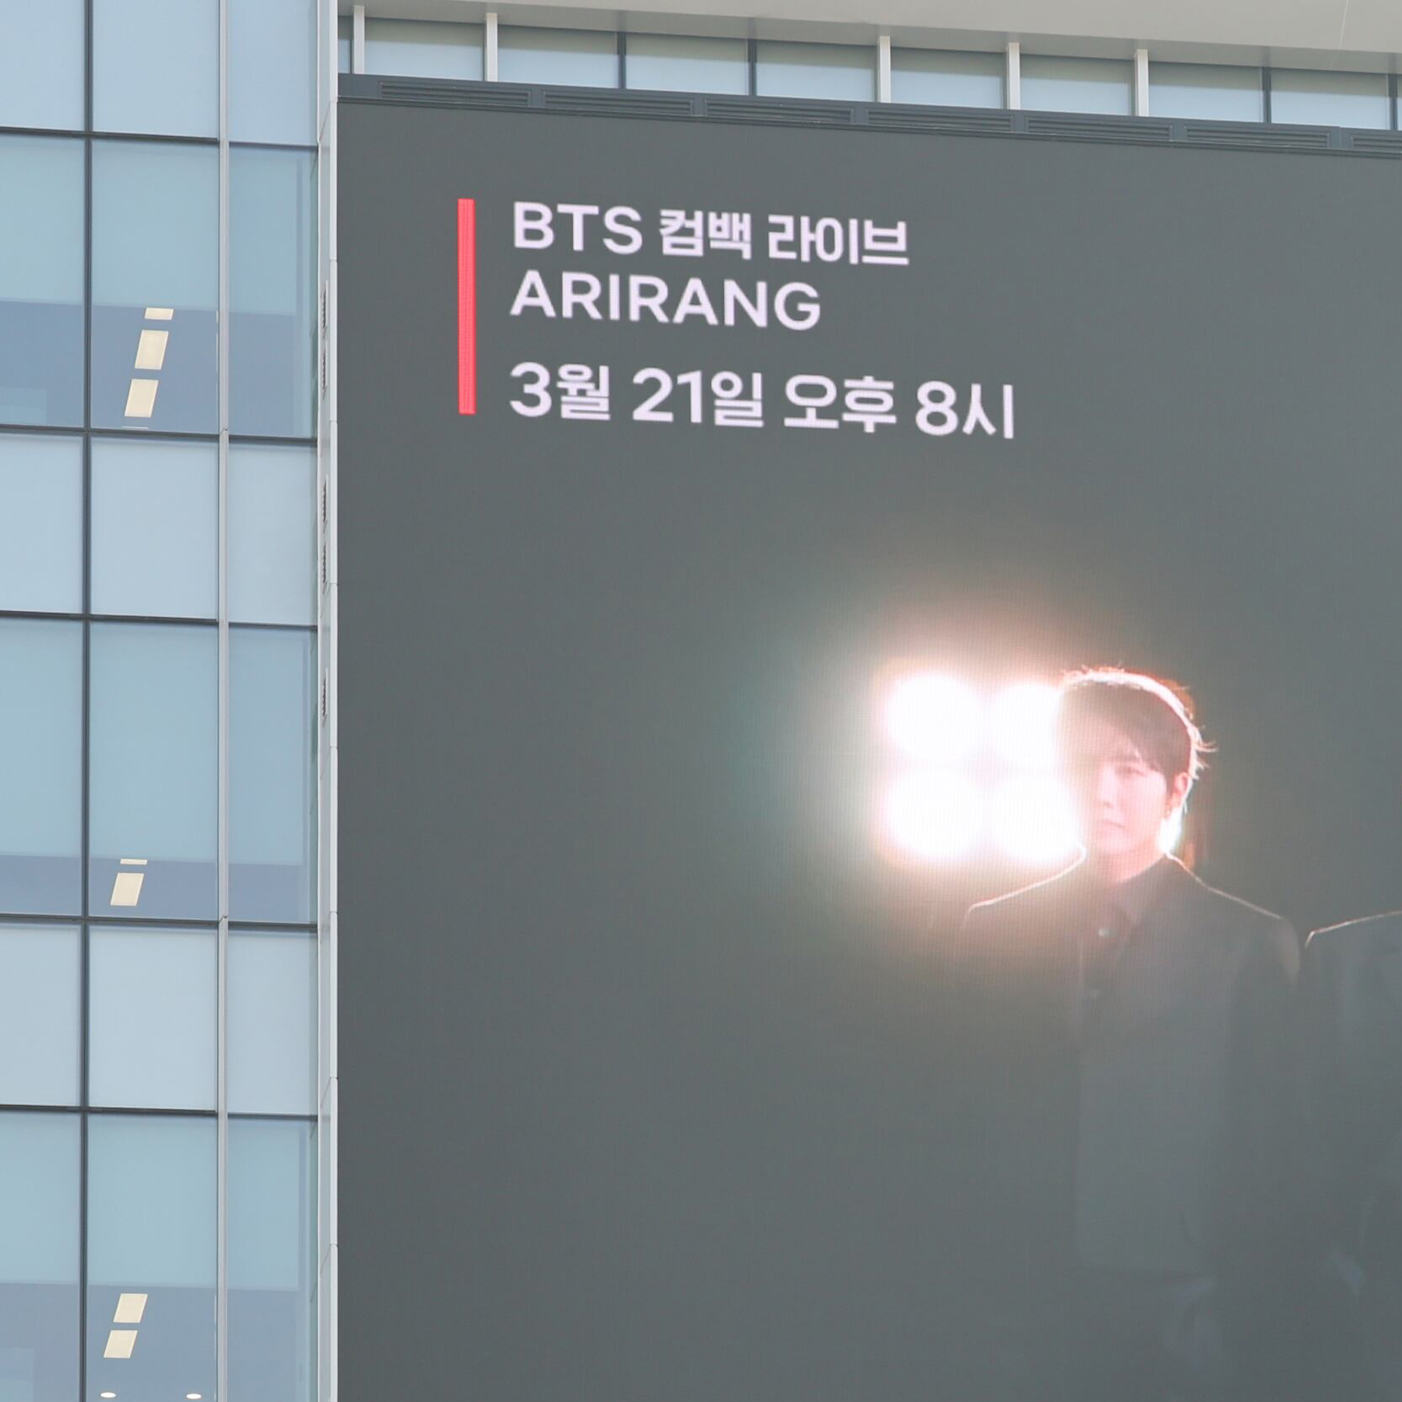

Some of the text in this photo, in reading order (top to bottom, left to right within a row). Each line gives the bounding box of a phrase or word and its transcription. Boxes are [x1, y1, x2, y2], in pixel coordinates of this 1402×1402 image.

[511, 200, 910, 266] BTS 컴백 라이브
[509, 269, 822, 332] ARIRANG
[508, 361, 1016, 441] 3월 21일 오후 8시
